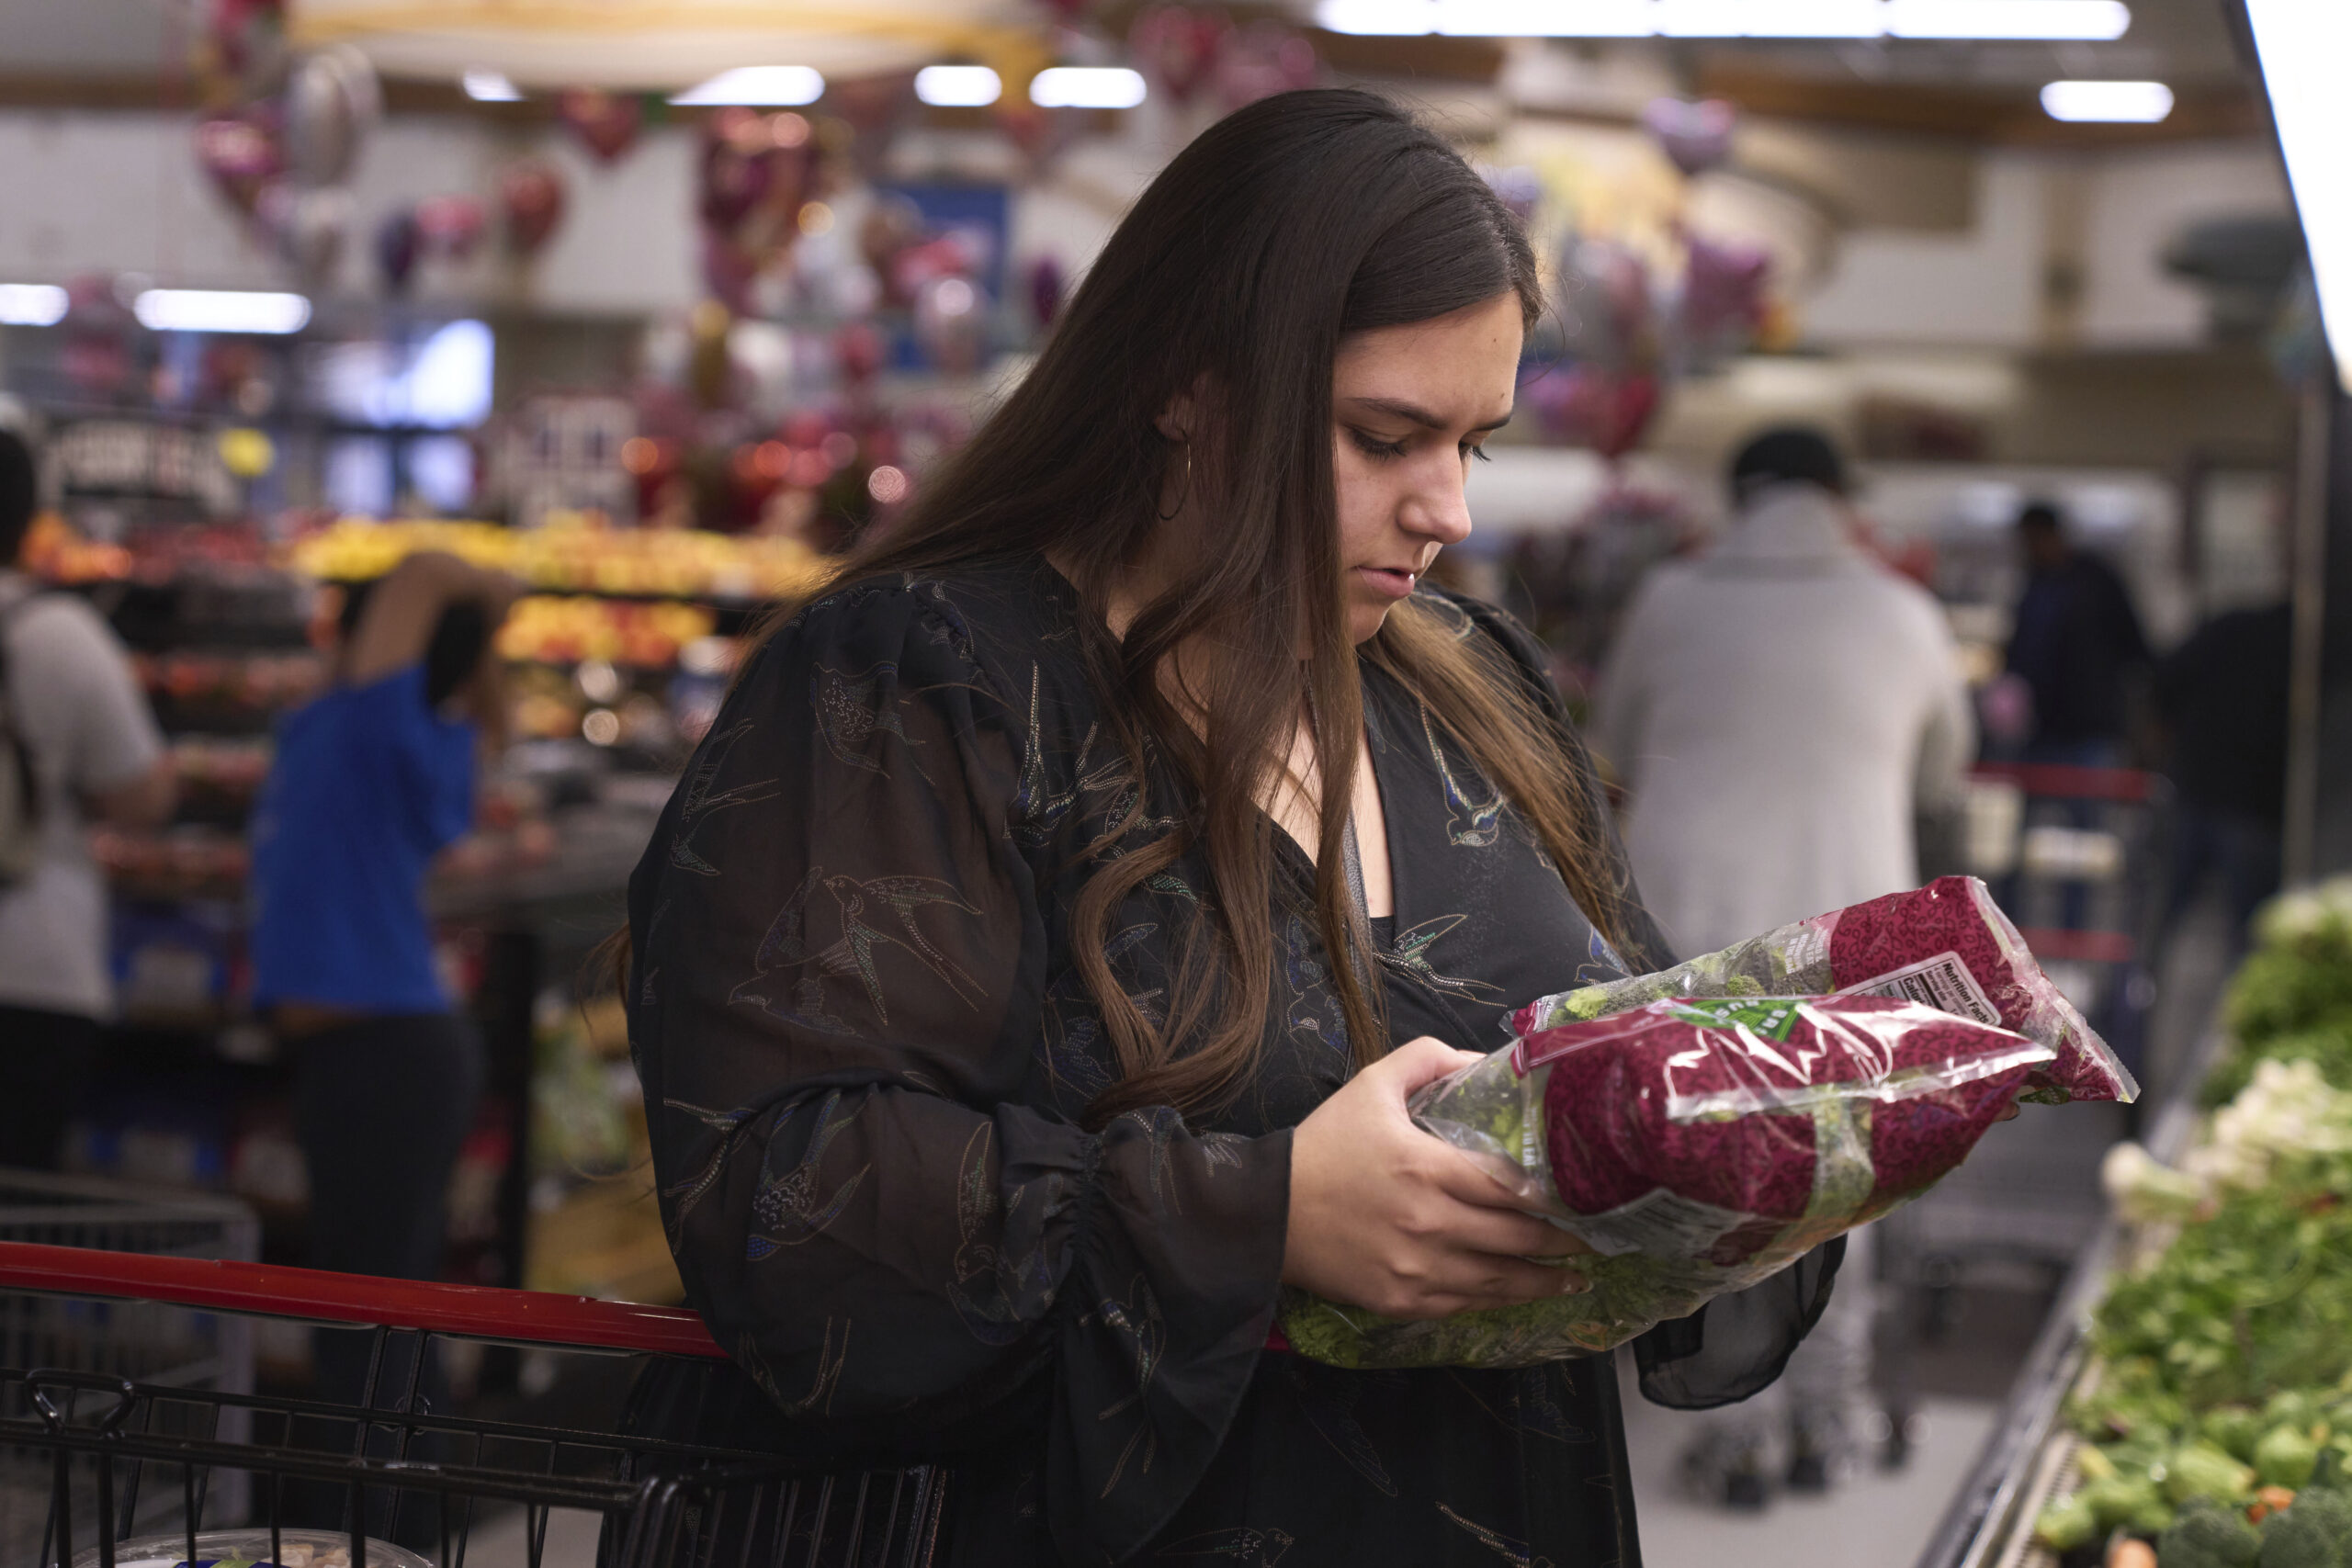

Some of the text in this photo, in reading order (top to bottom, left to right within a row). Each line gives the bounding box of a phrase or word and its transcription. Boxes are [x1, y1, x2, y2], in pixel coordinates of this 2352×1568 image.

[1925, 970, 1940, 992] Serving
[1942, 962, 1989, 1023] Nutrition Facts
